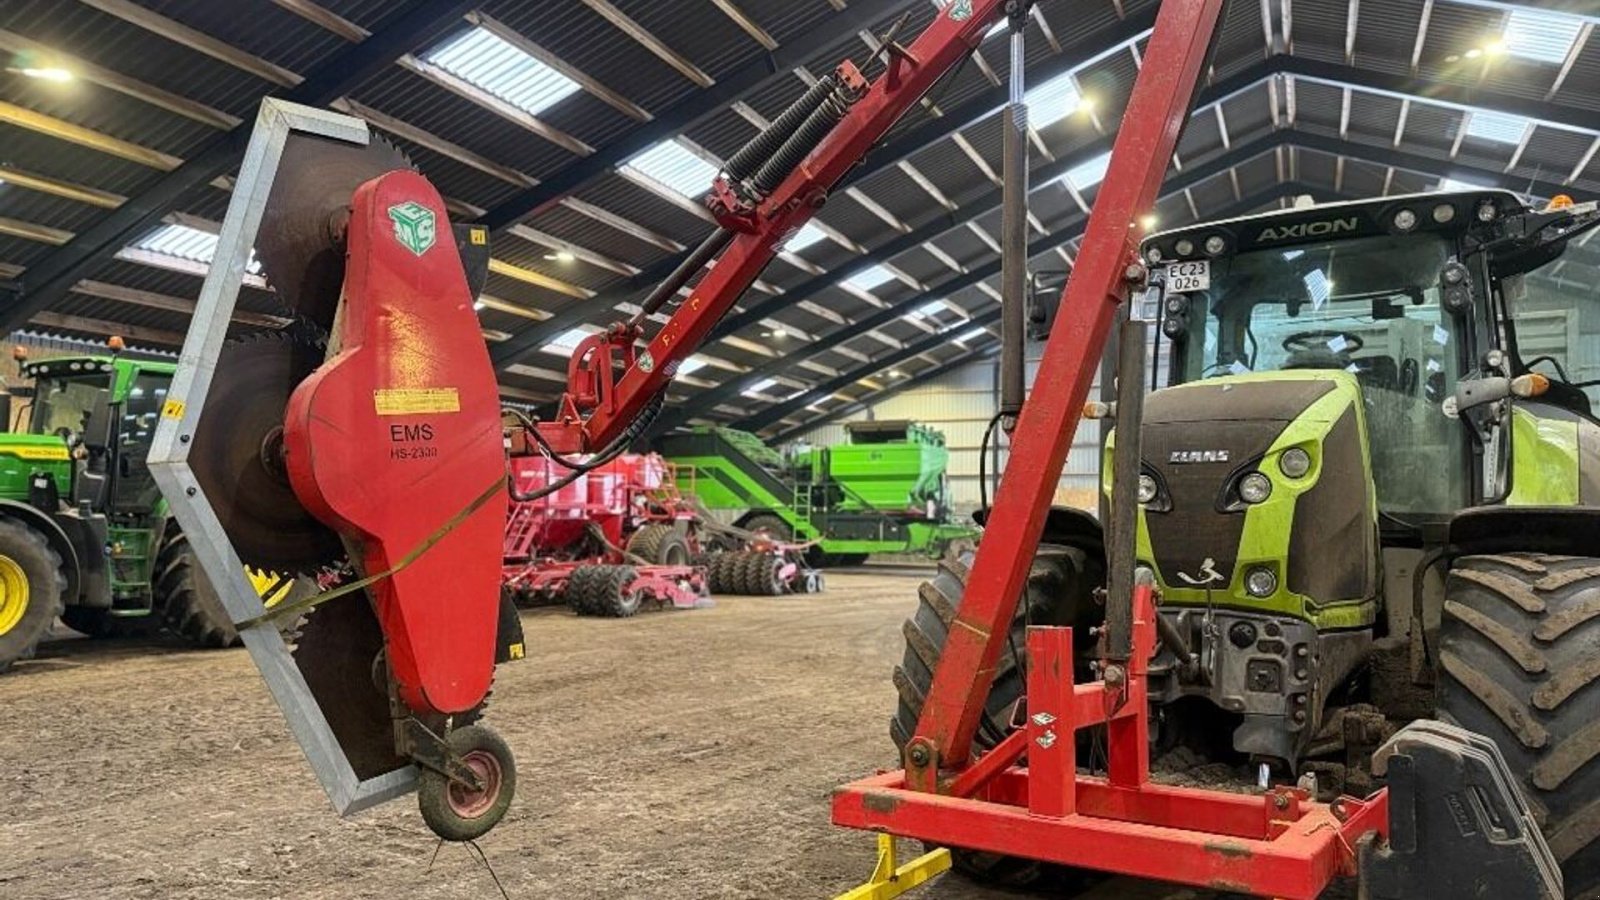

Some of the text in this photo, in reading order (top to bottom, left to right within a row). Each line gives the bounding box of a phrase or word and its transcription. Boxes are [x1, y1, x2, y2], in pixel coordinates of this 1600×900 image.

[1256, 217, 1358, 242] AXION
[1170, 262, 1205, 277] EC23
[1174, 277, 1199, 290] 026
[391, 423, 434, 441] EMS
